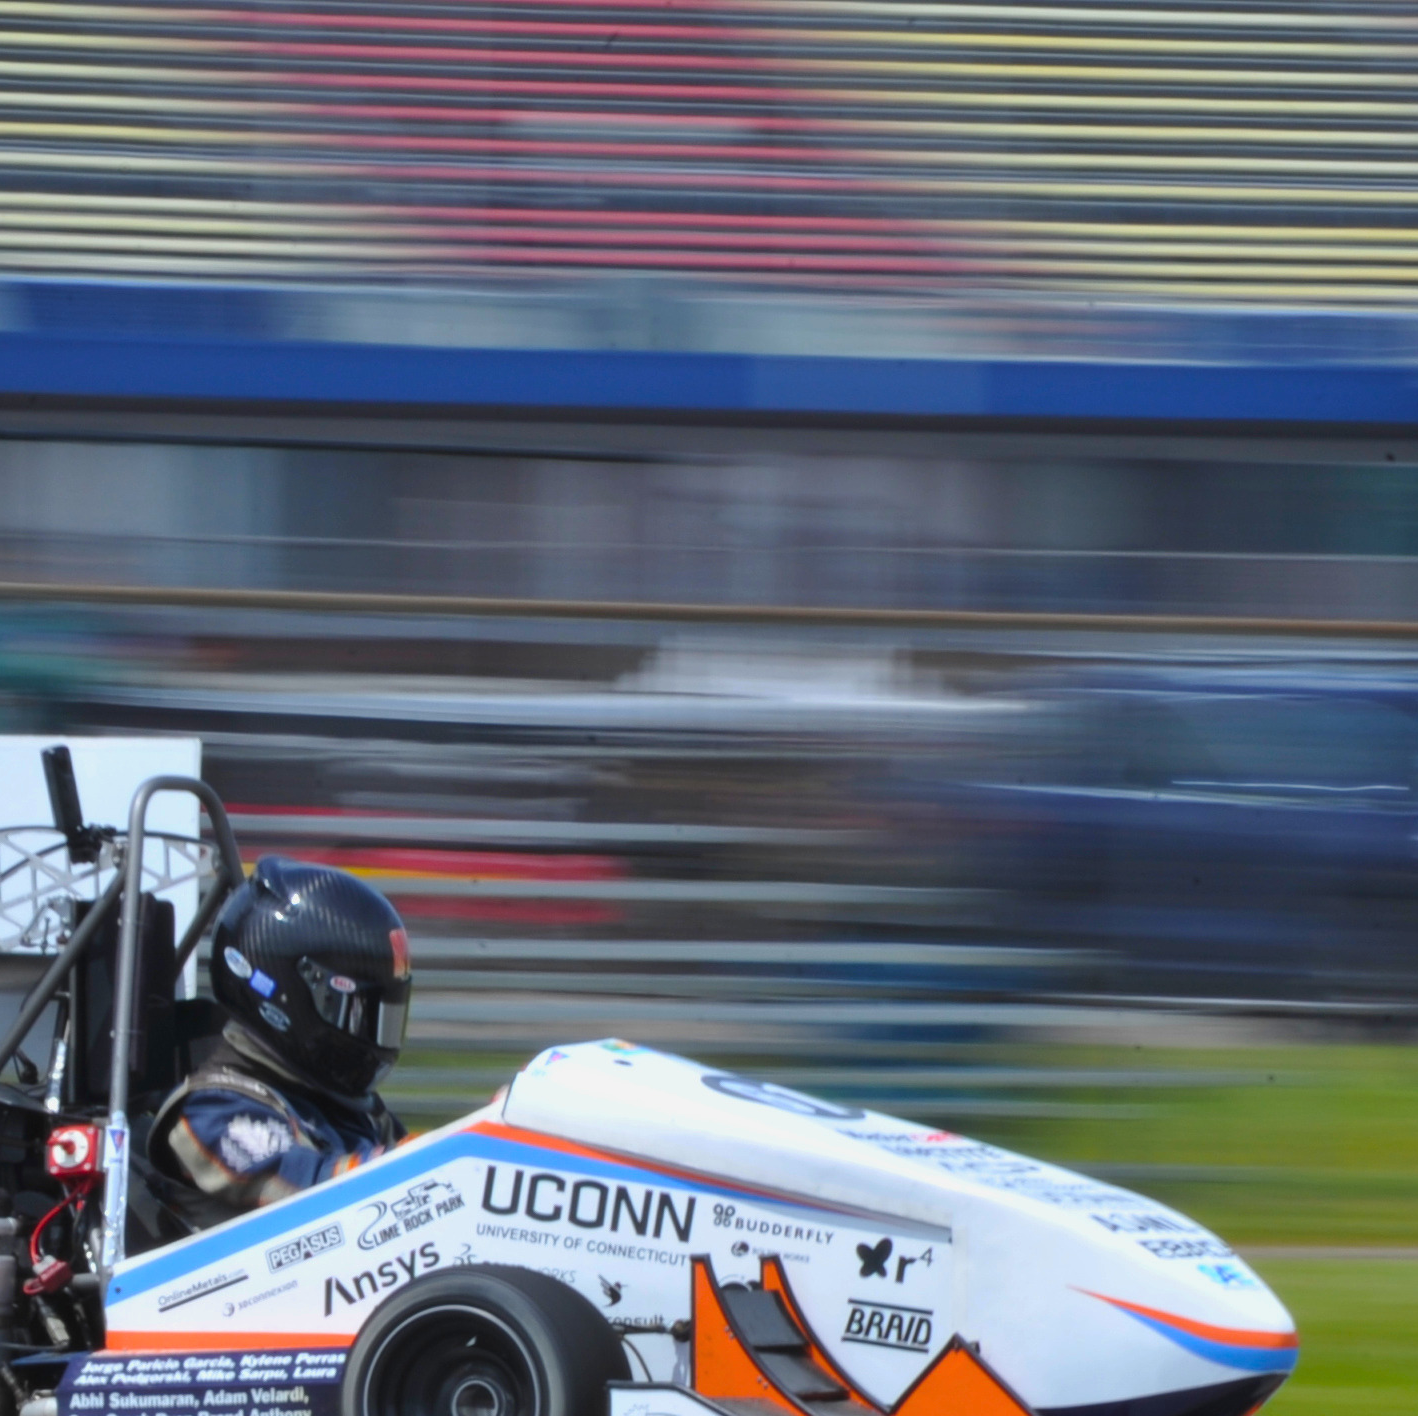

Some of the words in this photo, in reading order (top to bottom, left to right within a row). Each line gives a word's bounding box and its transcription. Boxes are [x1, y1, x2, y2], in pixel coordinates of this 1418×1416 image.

[372, 1225, 400, 1247] LIME
[404, 1210, 434, 1233] ROCK
[436, 1193, 466, 1219] PARK
[482, 1165, 696, 1243] UCONN
[268, 1225, 342, 1270] PEGASUS
[476, 1223, 561, 1249] UNIVERSITY
[563, 1236, 584, 1251] OF
[586, 1240, 689, 1267] CONNECTICUT
[735, 1217, 835, 1245] BUDDERFLY
[325, 1242, 440, 1317] Ansys
[845, 1308, 933, 1346] BRAID
[81, 1361, 123, 1374] Jorge
[196, 1369, 236, 1382] Mike
[69, 1392, 104, 1409] Abhi
[109, 1391, 200, 1409] Sukumaran,
[203, 1389, 248, 1406] Adam
[250, 1386, 309, 1404] Velardi,
